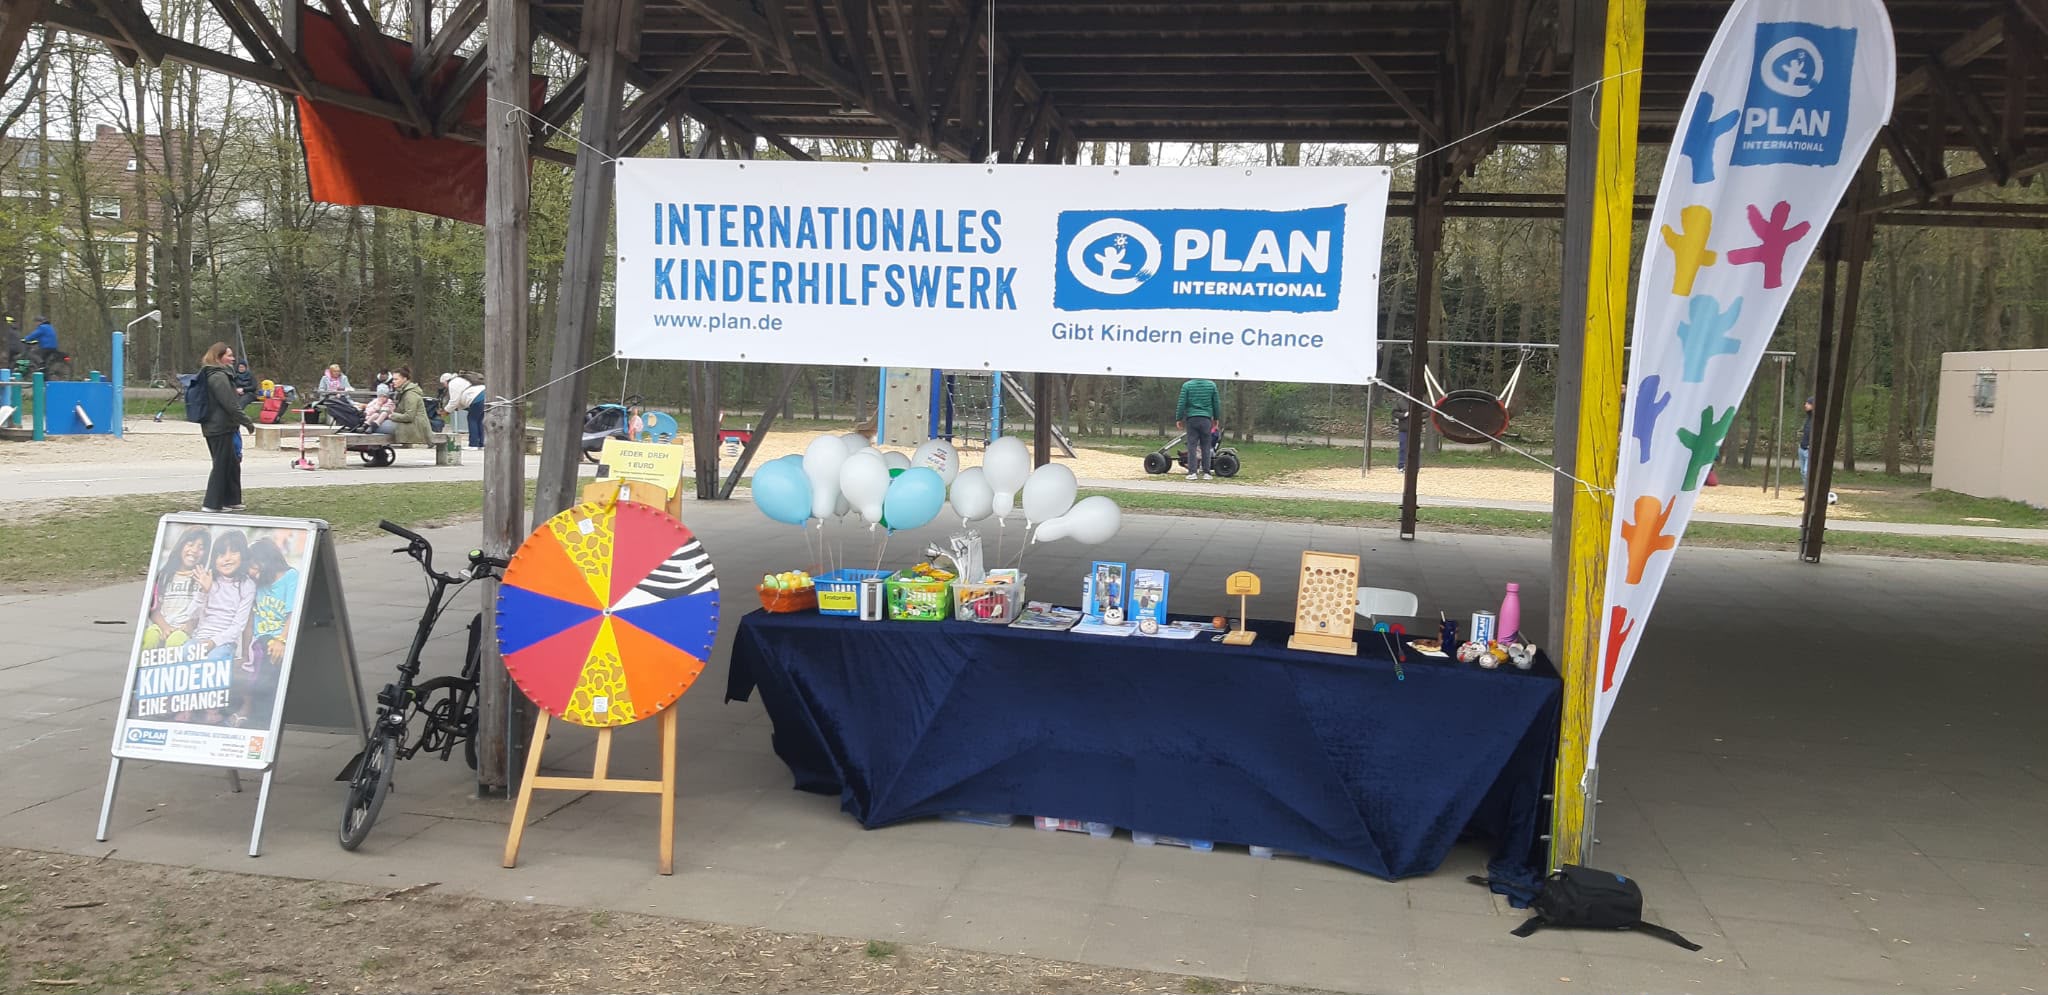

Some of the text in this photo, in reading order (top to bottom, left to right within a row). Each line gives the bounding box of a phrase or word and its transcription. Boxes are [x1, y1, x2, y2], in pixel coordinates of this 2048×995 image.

[1743, 107, 1831, 137] PLAN
[1742, 140, 1825, 152] INTERNATIONAL
[654, 202, 1002, 254] INTERNATIONALES
[1173, 229, 1331, 274] PLAN
[654, 257, 1018, 311] KINDERHILFSWERK
[1172, 280, 1327, 298] INTERNATIONAL
[653, 312, 783, 332] www.plan.de
[1051, 322, 1324, 348] Gibt Kindern eine Chance
[619, 449, 669, 460] JEDER DREH
[633, 462, 655, 470] EURO
[141, 642, 209, 667] GEBEN SIE
[138, 659, 231, 696] KINDERN
[138, 689, 230, 717] EINE CHANCE!
[143, 730, 167, 740] PLAN
